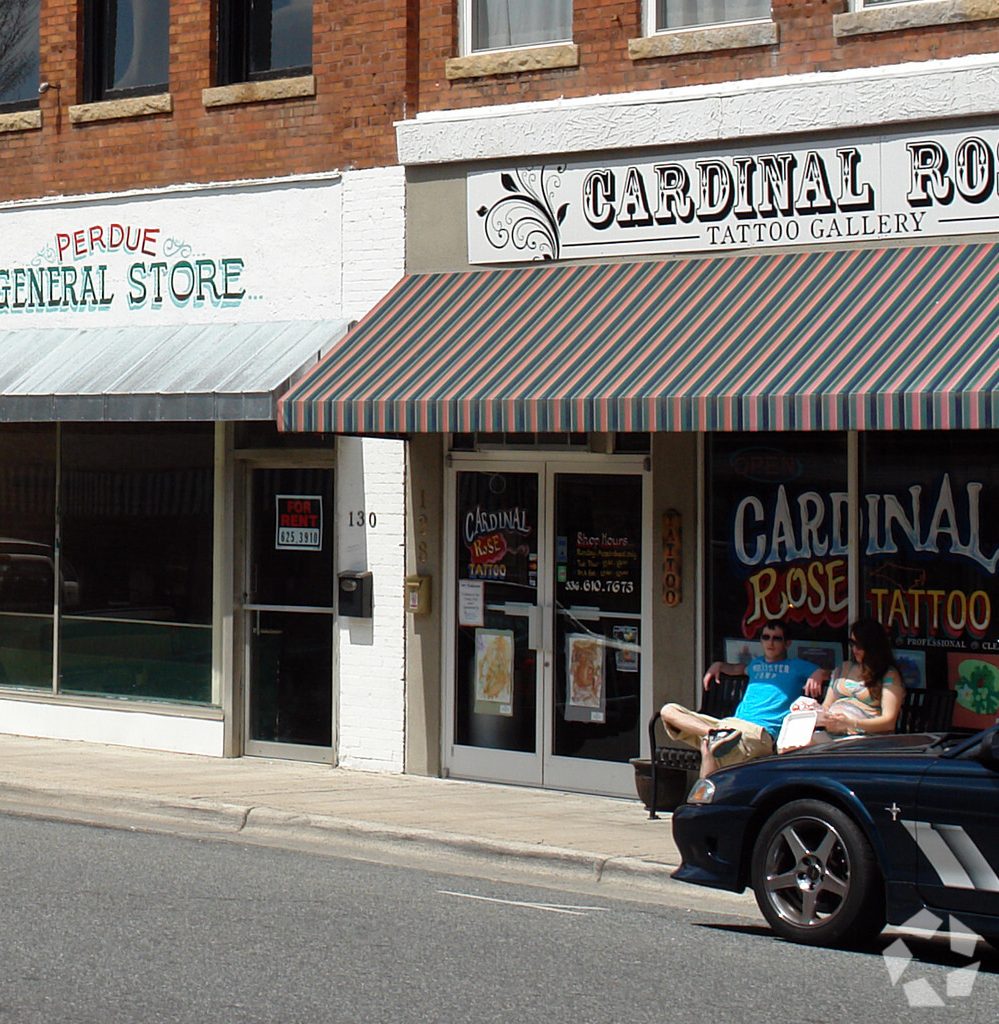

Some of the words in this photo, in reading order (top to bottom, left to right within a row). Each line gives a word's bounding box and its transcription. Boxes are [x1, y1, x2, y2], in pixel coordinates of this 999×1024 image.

[582, 147, 875, 230] CARDINAL
[906, 136, 999, 207] RO
[56, 223, 161, 263] PERDUE
[706, 220, 800, 245] TATTOO
[810, 211, 927, 240] GALLERY
[128, 257, 247, 307] STORE
[280, 514, 318, 527] RENT
[286, 500, 312, 513] FOR
[348, 511, 377, 528] 130
[465, 506, 531, 542] CARDINAL
[468, 564, 507, 577] TATTOO
[665, 514, 676, 605] TATTOO
[746, 559, 849, 626] ROSE
[871, 588, 992, 631] TATTOO
[907, 638, 967, 649] PROFESSIONAL
